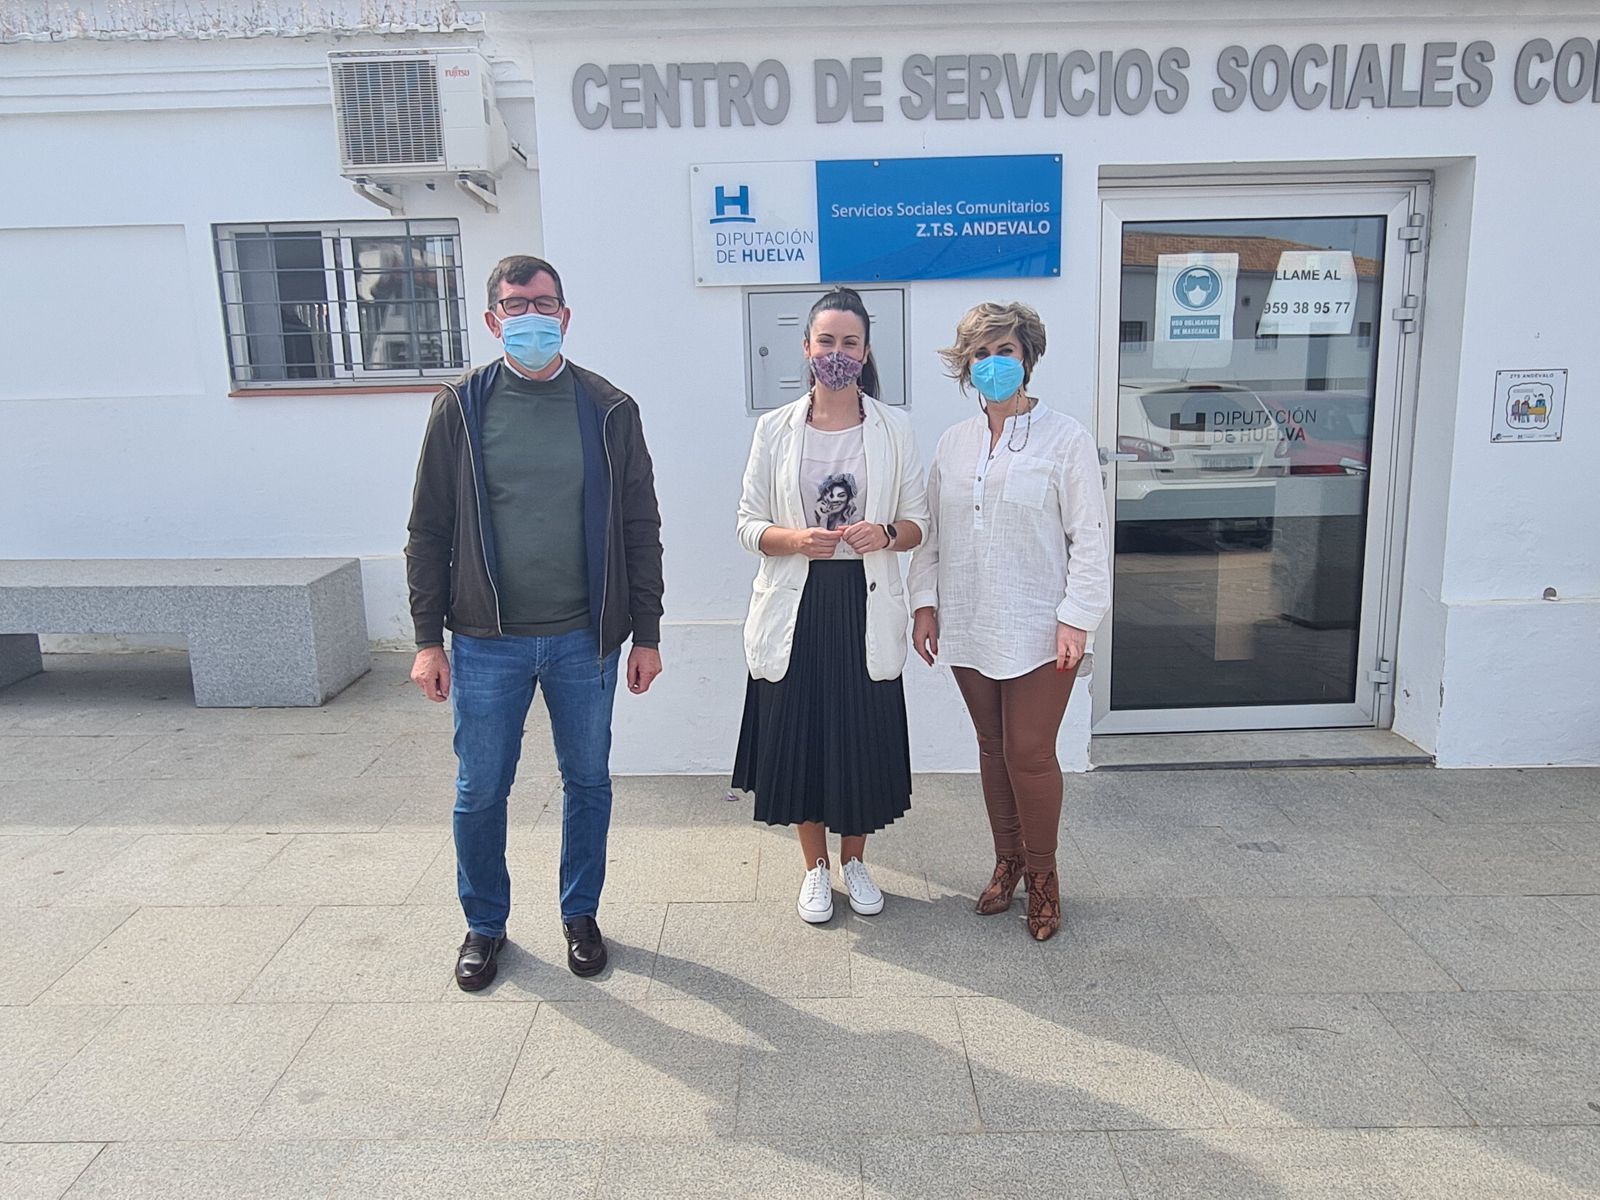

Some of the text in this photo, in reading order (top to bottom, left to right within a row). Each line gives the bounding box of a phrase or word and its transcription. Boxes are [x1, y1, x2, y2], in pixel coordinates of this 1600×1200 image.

[572, 36, 1600, 130] CENTRO DE SERVICIOS SOCIALES CO
[831, 199, 1050, 218] Servicios Sociales Comunitarios
[716, 228, 815, 247] DIPUTACIÓN
[916, 220, 1051, 238] Z.T.S. ANDEVALO
[717, 248, 806, 264] DE HUELVA
[1275, 269, 1342, 280] LLAME AL
[1263, 301, 1351, 314] 959 38 95 77
[1214, 407, 1317, 426] DIPUTACIÓN
